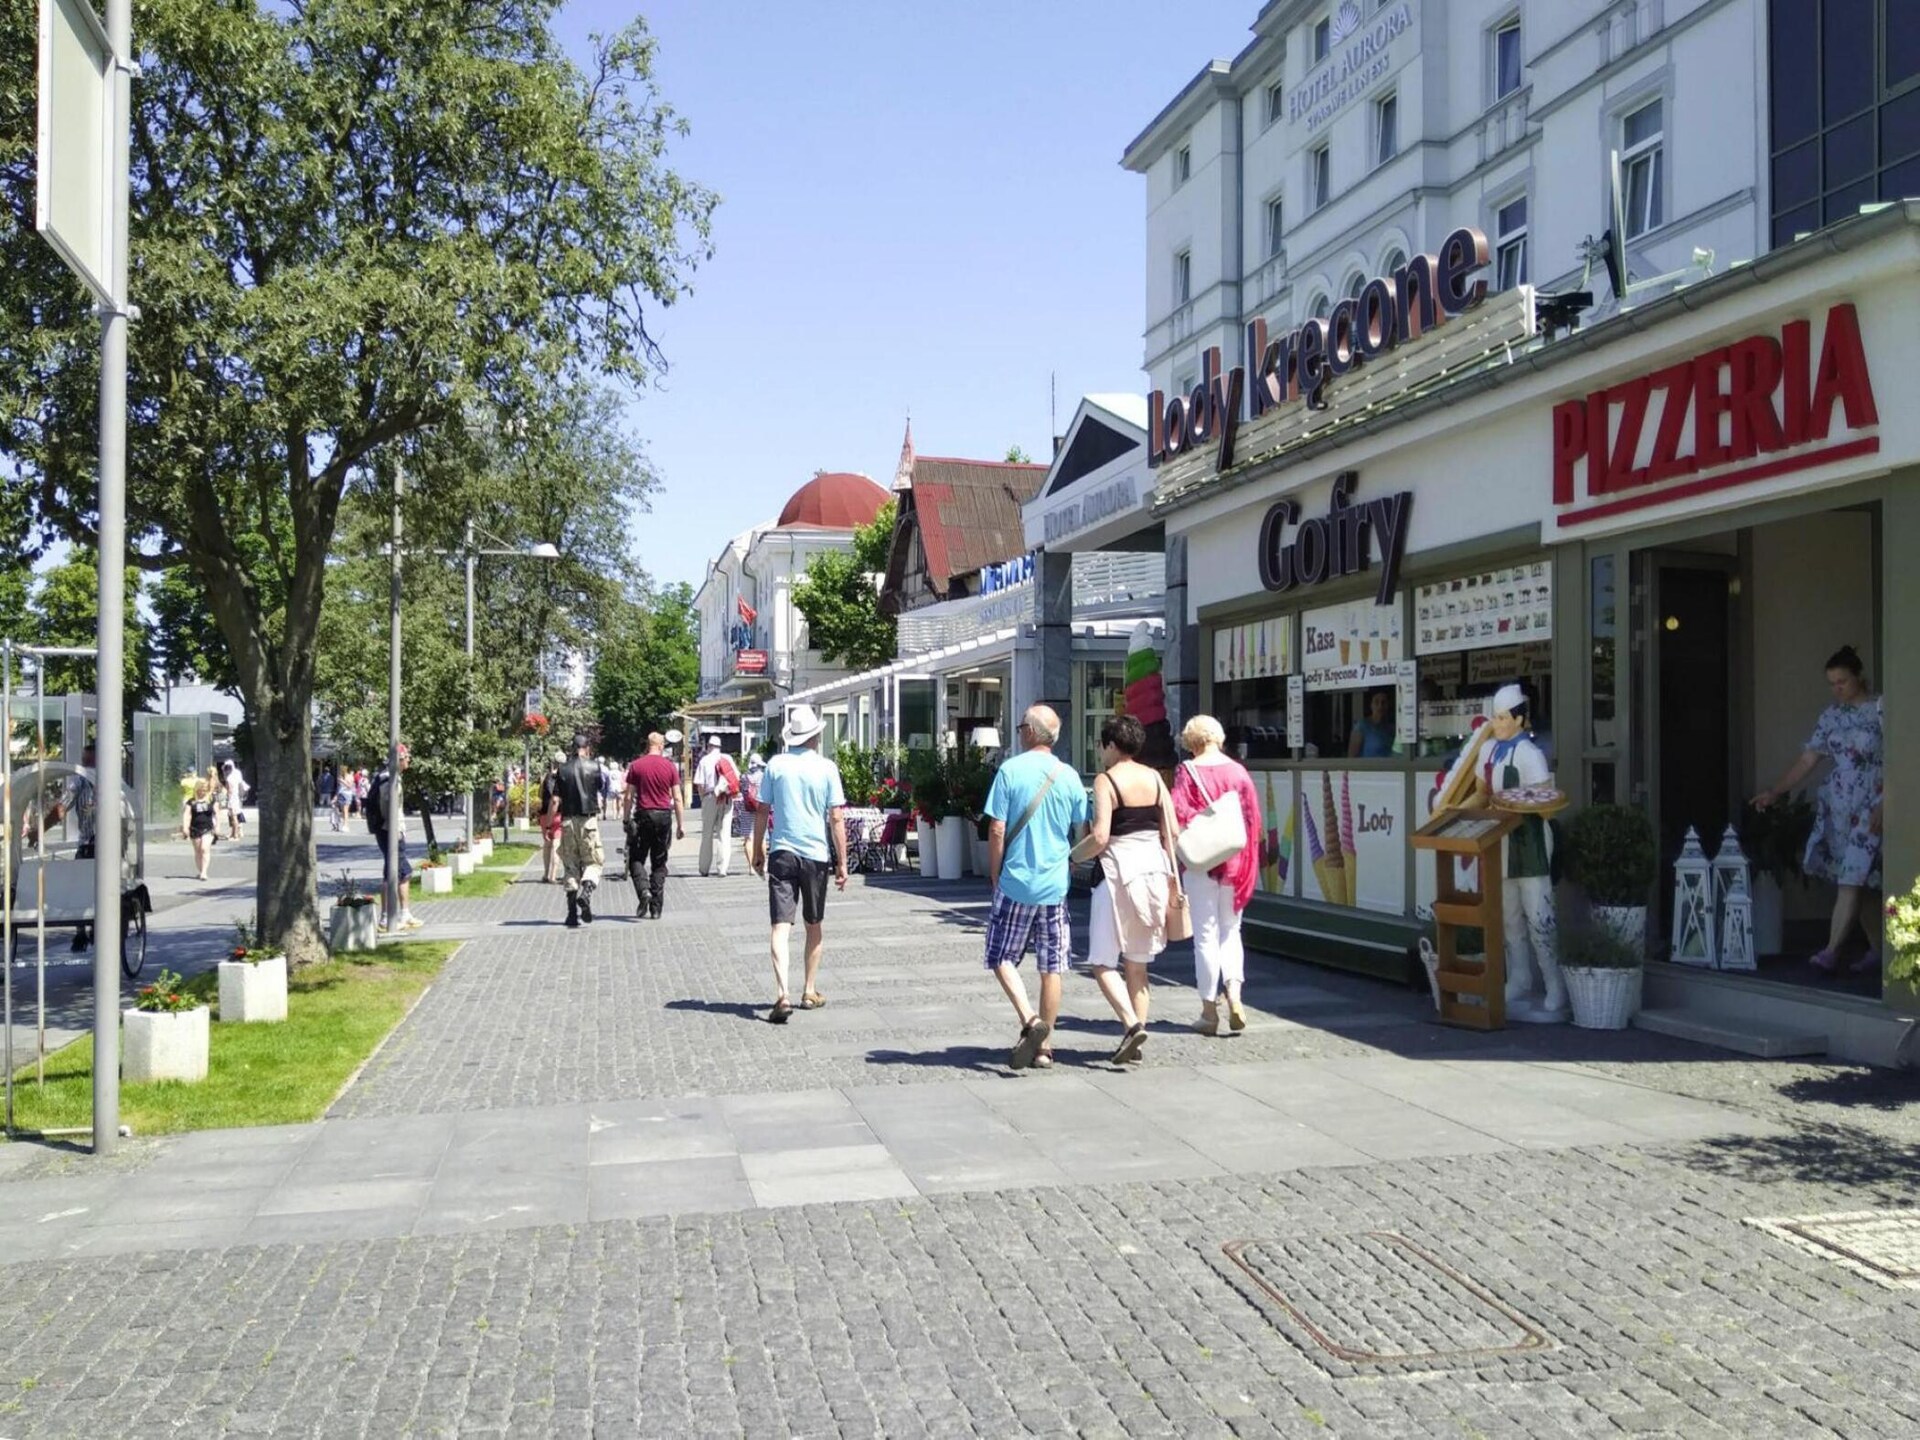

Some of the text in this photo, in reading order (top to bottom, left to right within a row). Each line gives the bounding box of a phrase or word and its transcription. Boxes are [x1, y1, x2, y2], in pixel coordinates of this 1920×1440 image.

[1289, 3, 1413, 125] HOTEL AURORA
[1147, 226, 1490, 473] lody kręcone
[1552, 303, 1879, 505] PIZZERIA
[1258, 470, 1412, 606] Gofry
[1306, 626, 1335, 654] Kasa
[1360, 663, 1367, 680] 7
[1358, 803, 1394, 836] Lody
